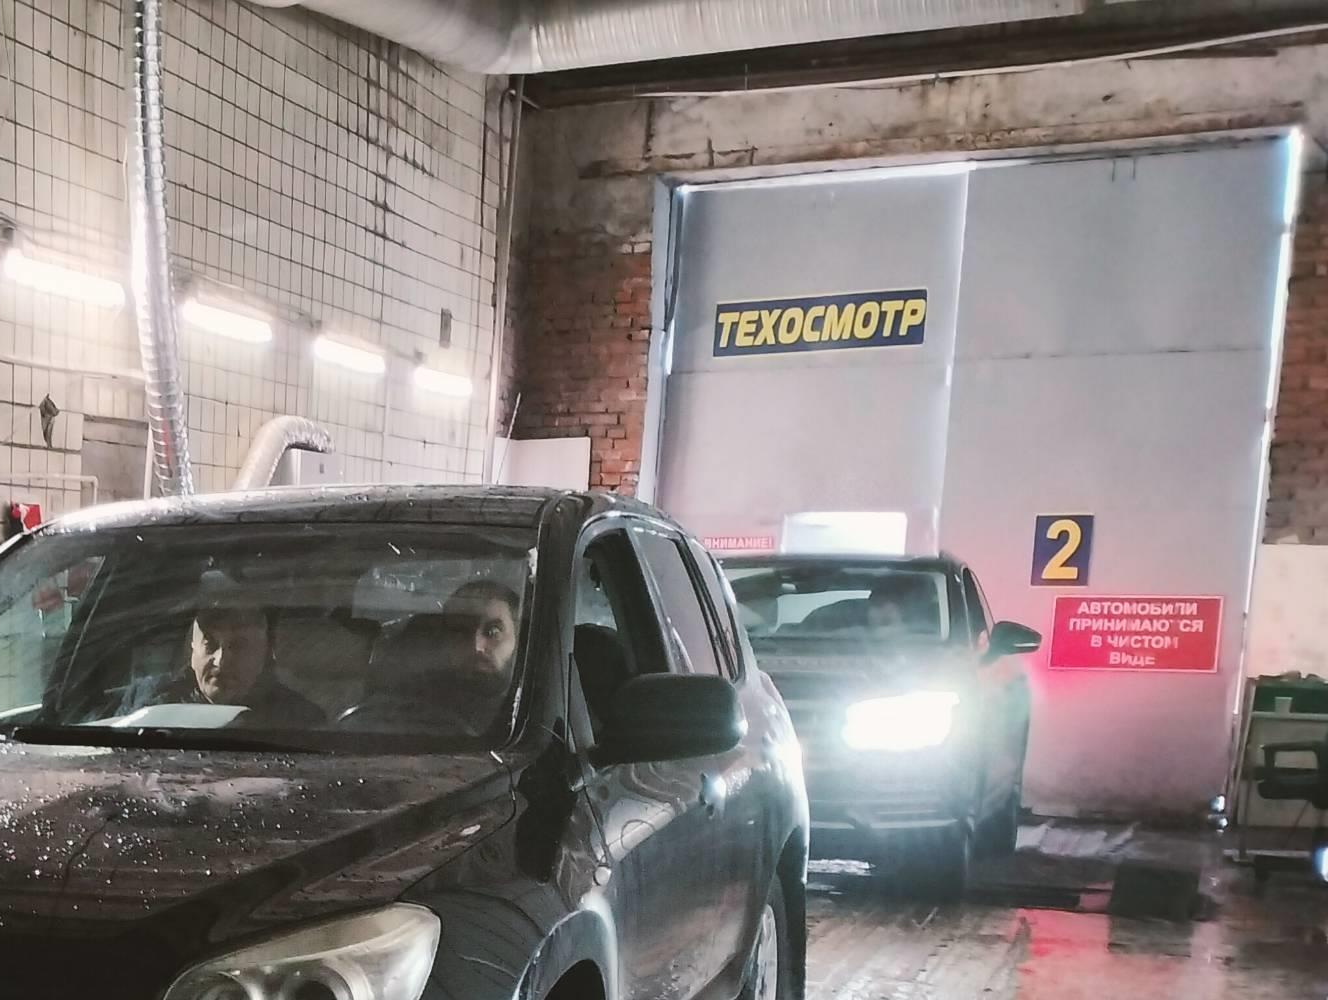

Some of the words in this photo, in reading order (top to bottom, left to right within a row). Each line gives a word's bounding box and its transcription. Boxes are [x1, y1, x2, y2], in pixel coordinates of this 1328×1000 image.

[717, 299, 926, 348] ТЕХОСМОТР
[1040, 518, 1082, 580] 2
[1077, 601, 1199, 616] АВТОМОБИЛИ
[1068, 617, 1204, 633] ПРИНИМАЮСЯ
[1090, 635, 1103, 648] В
[1107, 635, 1180, 649] ЧИСТОМ
